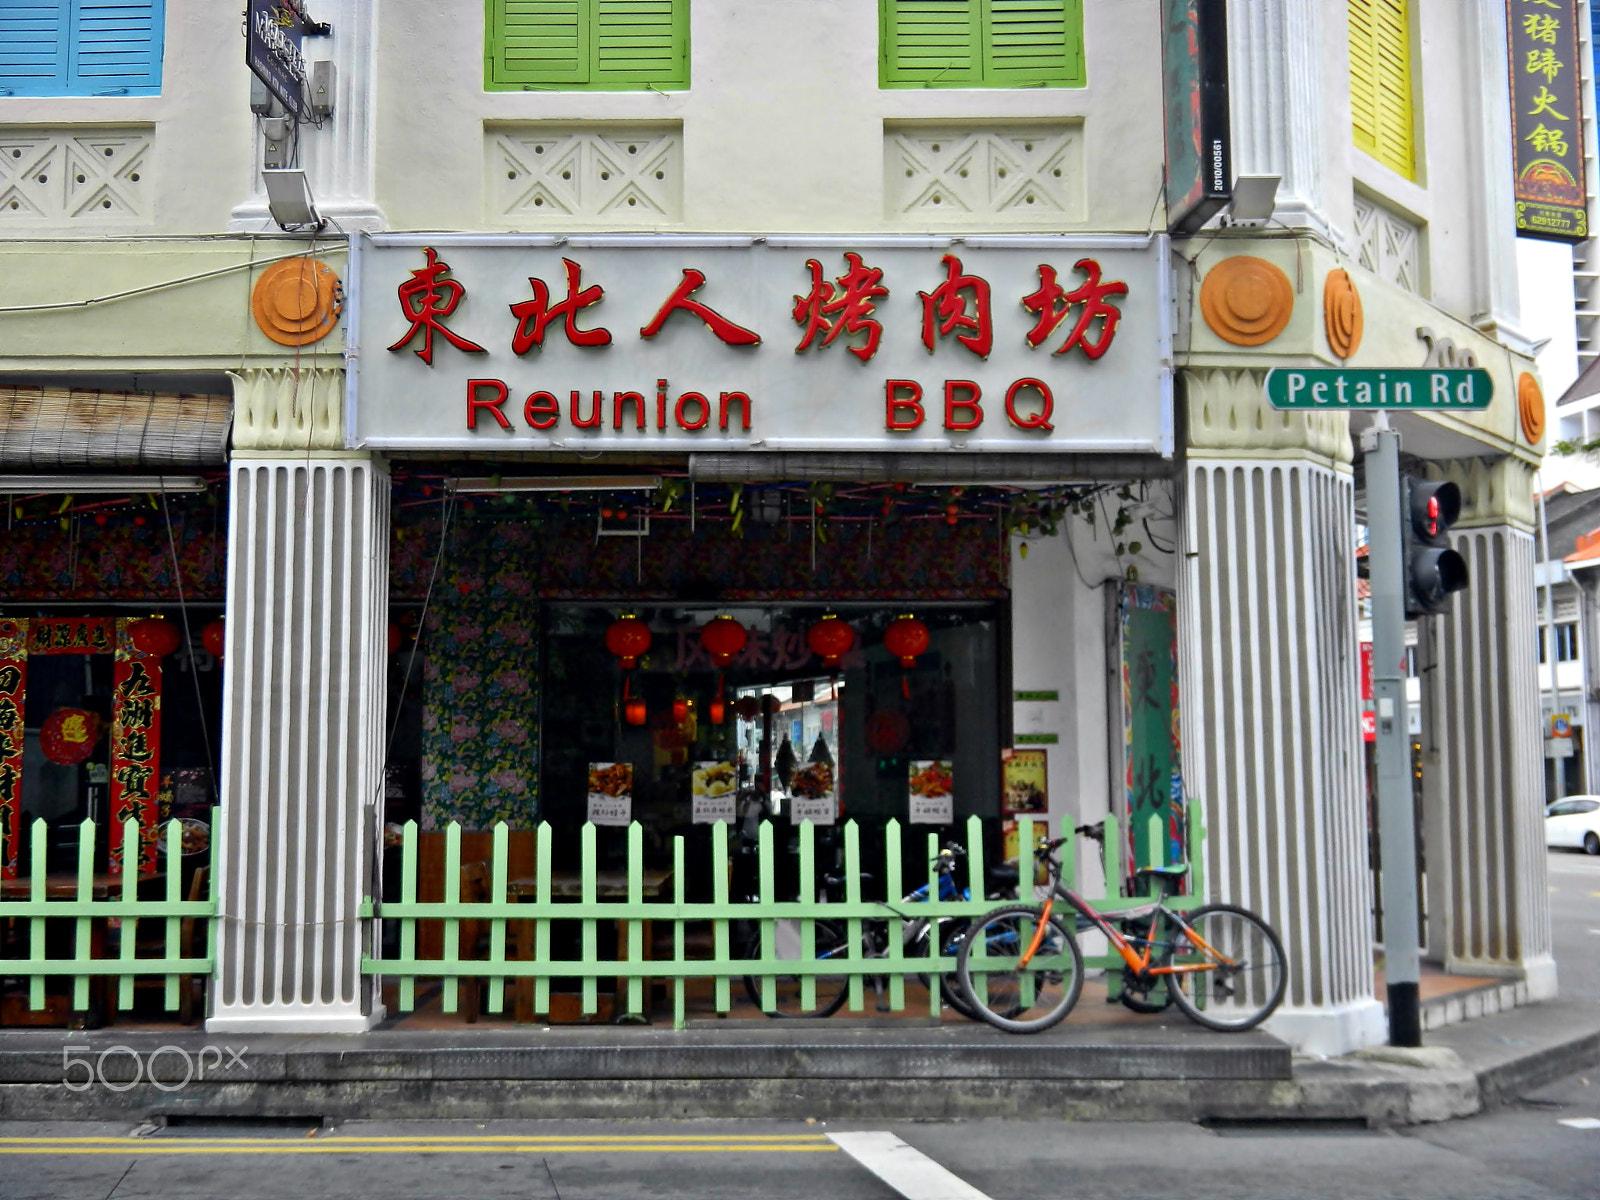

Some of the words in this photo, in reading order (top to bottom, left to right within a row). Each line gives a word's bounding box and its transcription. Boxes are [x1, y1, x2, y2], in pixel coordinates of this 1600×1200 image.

[1522, 0, 1570, 157] 猪蹄火锅
[1213, 139, 1223, 191] 2010/00561
[387, 247, 1130, 366] 東北人烤肉坊
[467, 378, 753, 431] Reunion
[886, 377, 1055, 432] BBQ
[1288, 373, 1412, 403] Petain
[1431, 373, 1474, 403] Rd
